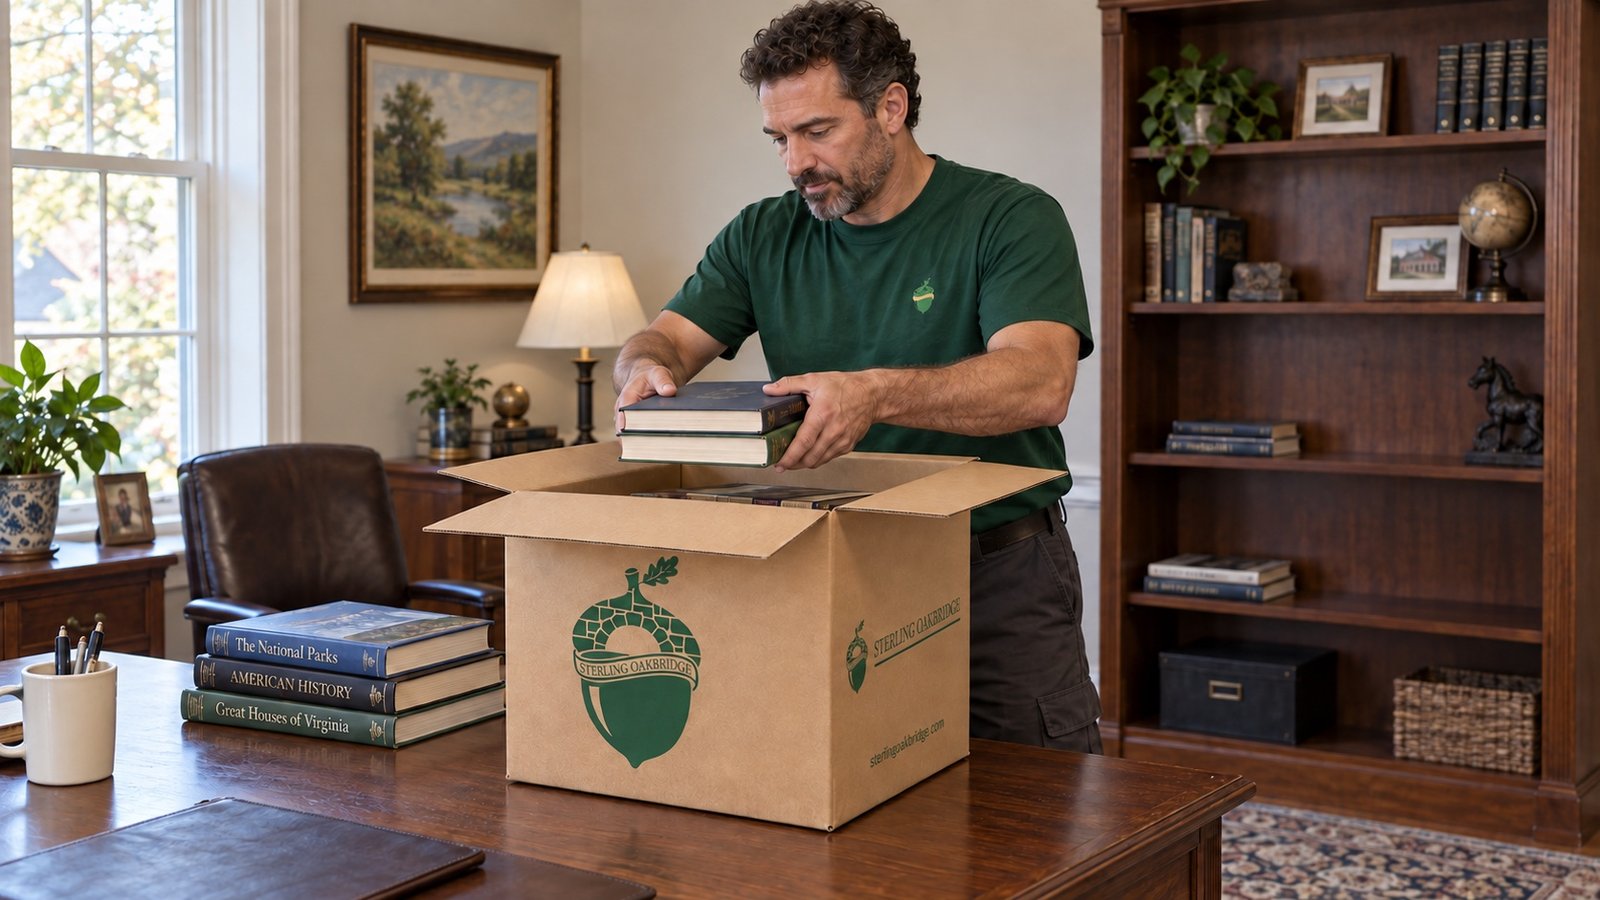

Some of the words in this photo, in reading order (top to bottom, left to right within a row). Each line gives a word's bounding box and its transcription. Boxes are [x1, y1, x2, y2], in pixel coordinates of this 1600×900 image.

[874, 622, 915, 658] STERLING
[917, 597, 961, 634] OAKBRIDGE
[235, 637, 256, 653] The
[258, 640, 304, 659] National
[308, 646, 338, 664] Parks
[580, 662, 629, 677] STERLING
[630, 658, 692, 675] OAKBRIDGE
[230, 671, 295, 691] AMERICAN
[298, 680, 353, 699] HISTORY
[215, 702, 246, 718] Great
[248, 706, 288, 724] Houses
[290, 712, 302, 727] of
[304, 714, 349, 734] Virginia
[870, 719, 945, 768] sterlingoakbridgecom
